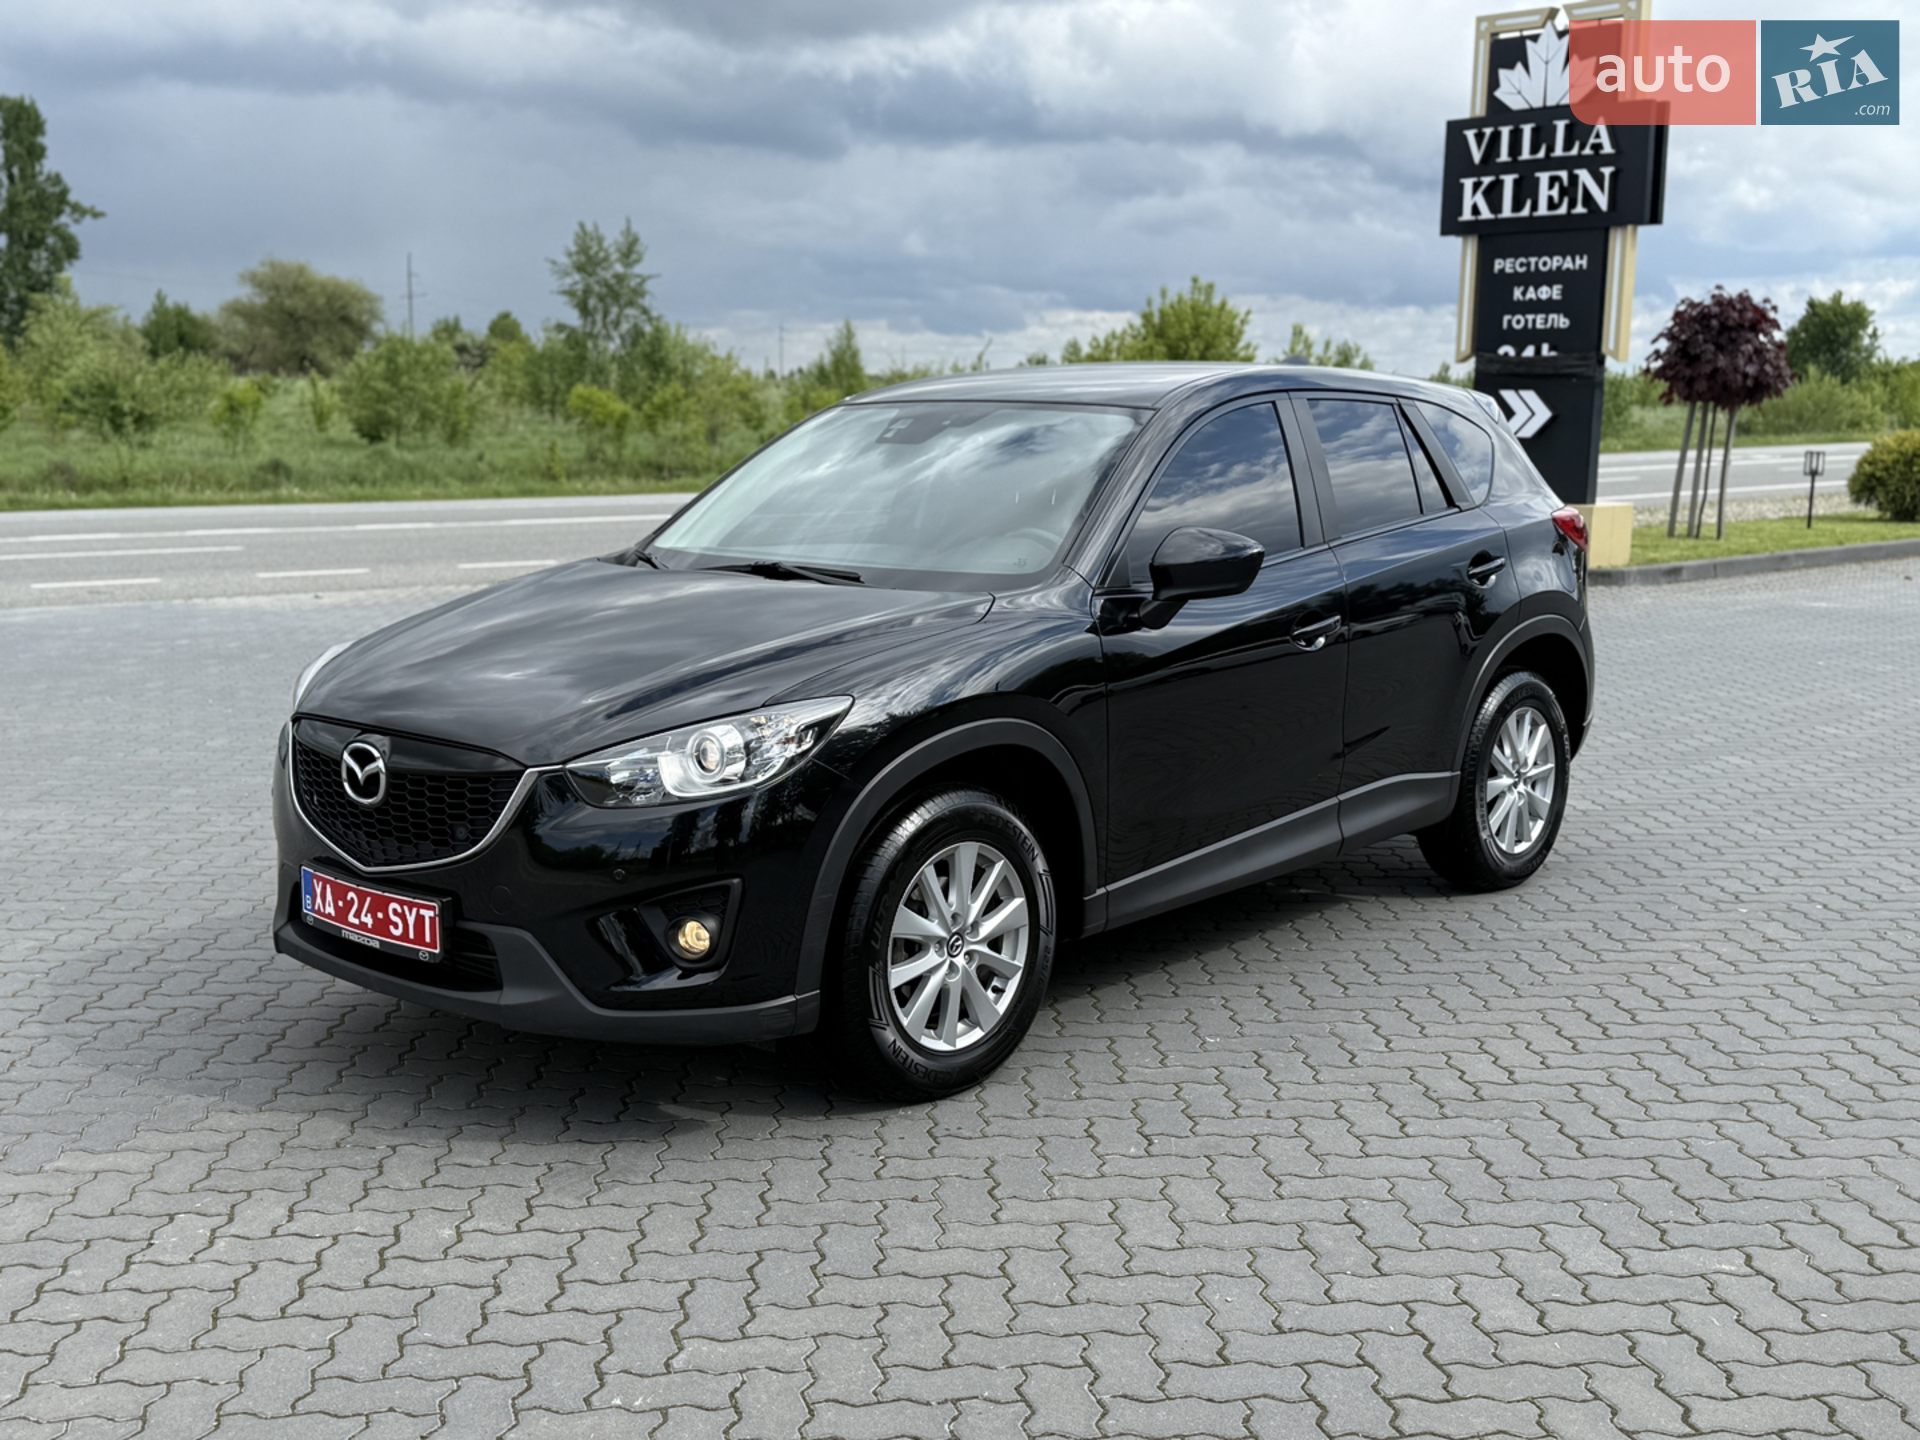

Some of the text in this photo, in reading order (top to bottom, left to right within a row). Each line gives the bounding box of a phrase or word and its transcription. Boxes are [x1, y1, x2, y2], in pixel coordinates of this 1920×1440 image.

[1462, 116, 1616, 166] VILLA
[1457, 166, 1616, 222] KLEN
[1493, 254, 1588, 274] РЕСТОРАН
[1513, 284, 1563, 302] КАФЕ
[1502, 313, 1571, 330] ГОТЕЛЬ
[306, 894, 312, 909] B
